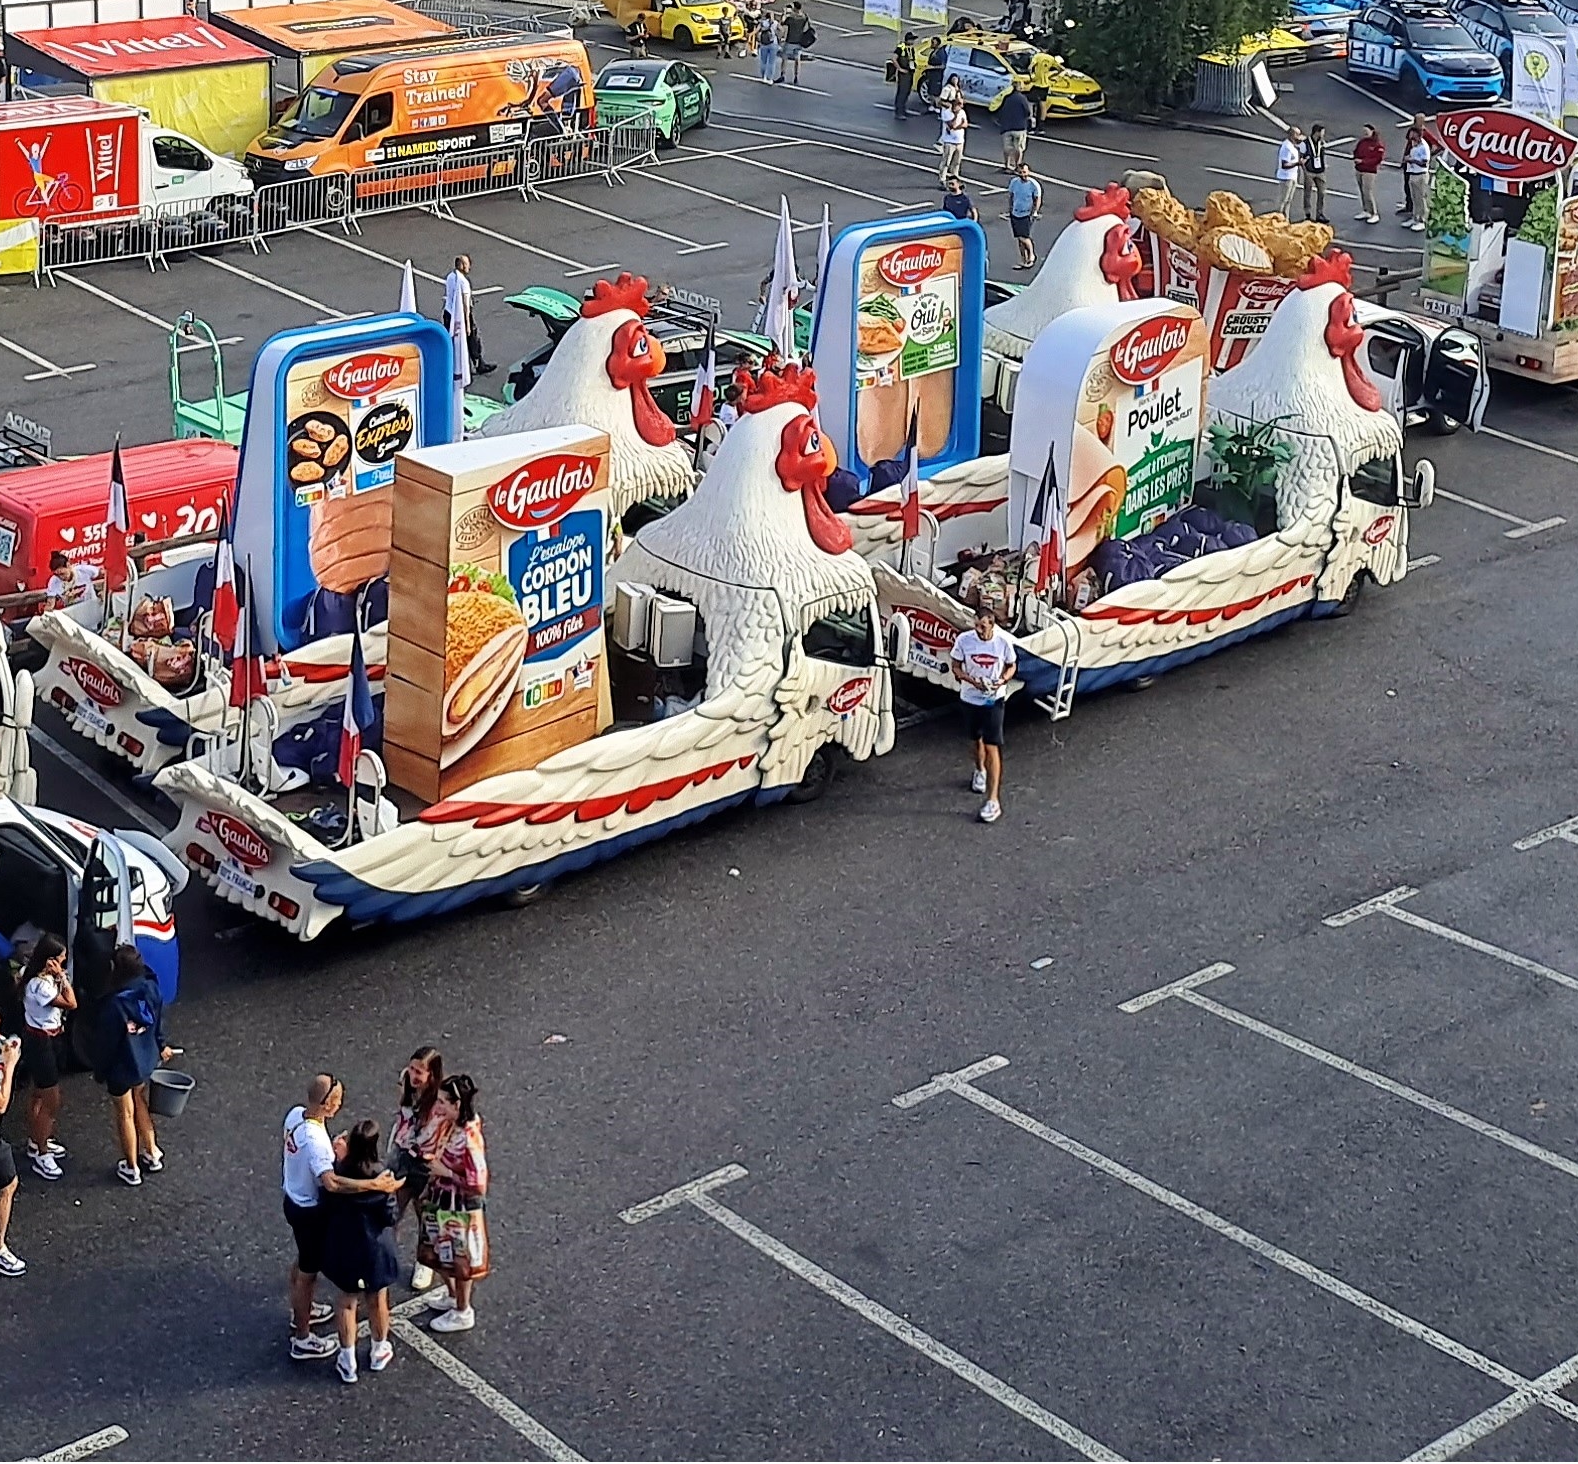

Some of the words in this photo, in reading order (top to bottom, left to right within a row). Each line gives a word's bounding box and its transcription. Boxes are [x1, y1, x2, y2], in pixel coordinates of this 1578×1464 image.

[78, 31, 200, 56] Vittel
[403, 68, 438, 86] Stay
[96, 132, 114, 182] Vittel
[1443, 116, 1457, 137] le
[1458, 116, 1566, 165] Gaulois
[889, 249, 942, 279] Gaulois
[910, 305, 938, 331] Oui
[1449, 303, 1463, 319] BO
[1115, 346, 1124, 363] le
[1123, 321, 1186, 375] Gaulois
[337, 358, 400, 391] Gaulois
[1127, 387, 1182, 437] Poulet
[355, 414, 413, 450] Express
[494, 485, 507, 508] le
[507, 461, 594, 519] Gaulois
[1125, 484, 1150, 515] DANS
[1150, 476, 1165, 503] LES
[521, 545, 592, 594] CORDON
[528, 532, 586, 570] L'escalope
[523, 570, 593, 629] BLEU
[535, 626, 562, 650] 100%
[562, 615, 585, 639] filet
[77, 663, 121, 705] Gaulois
[219, 818, 270, 864] Gaulois
